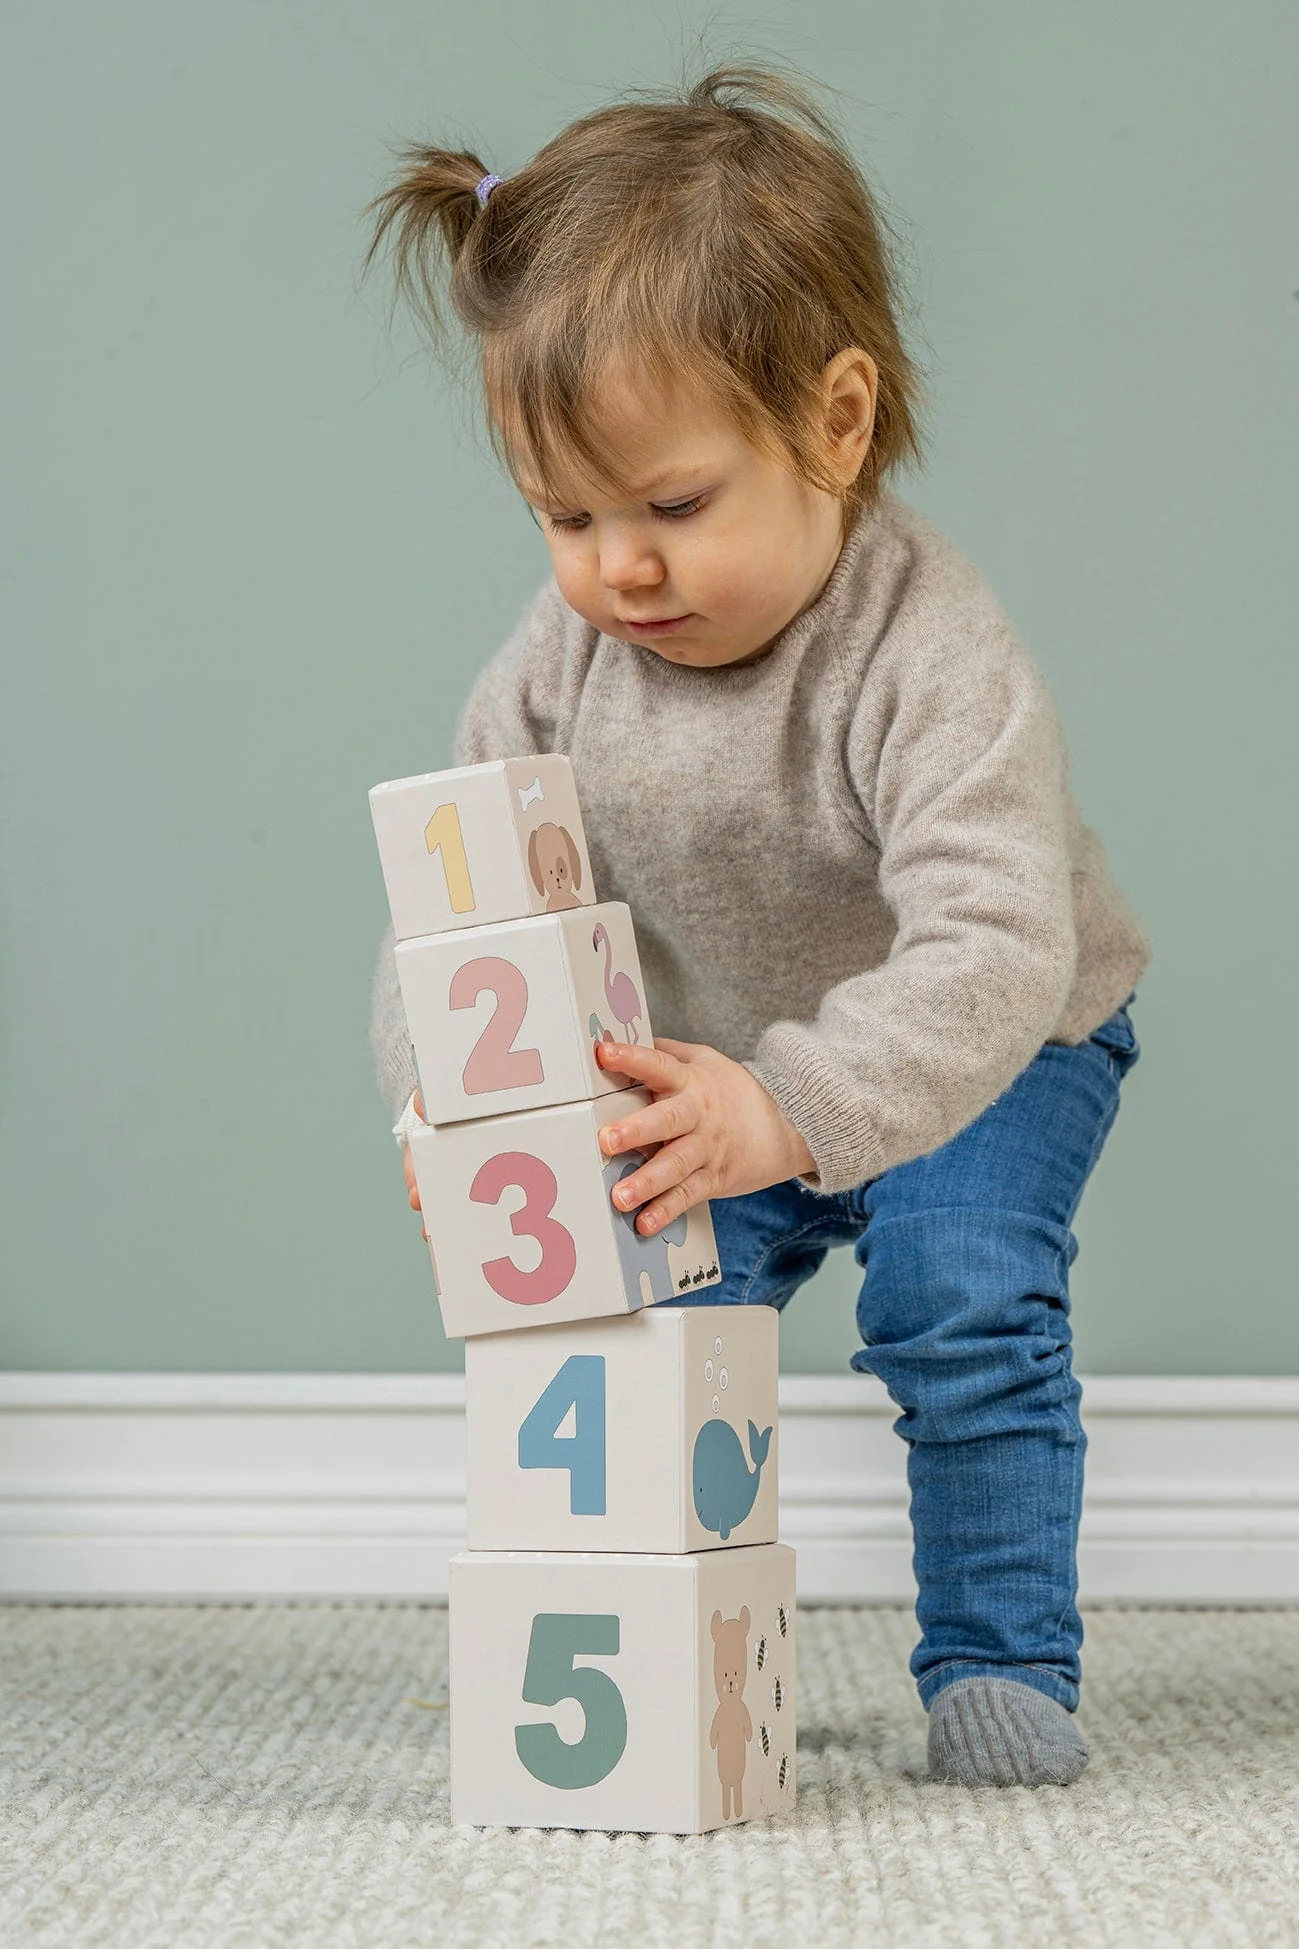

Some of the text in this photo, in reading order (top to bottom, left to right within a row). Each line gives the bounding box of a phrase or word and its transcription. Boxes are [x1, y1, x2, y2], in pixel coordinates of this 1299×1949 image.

[424, 802, 476, 915] 1
[450, 957, 545, 1095] 2
[469, 1151, 577, 1306] 3
[518, 1355, 606, 1516] 4
[515, 1613, 627, 1789] 5
